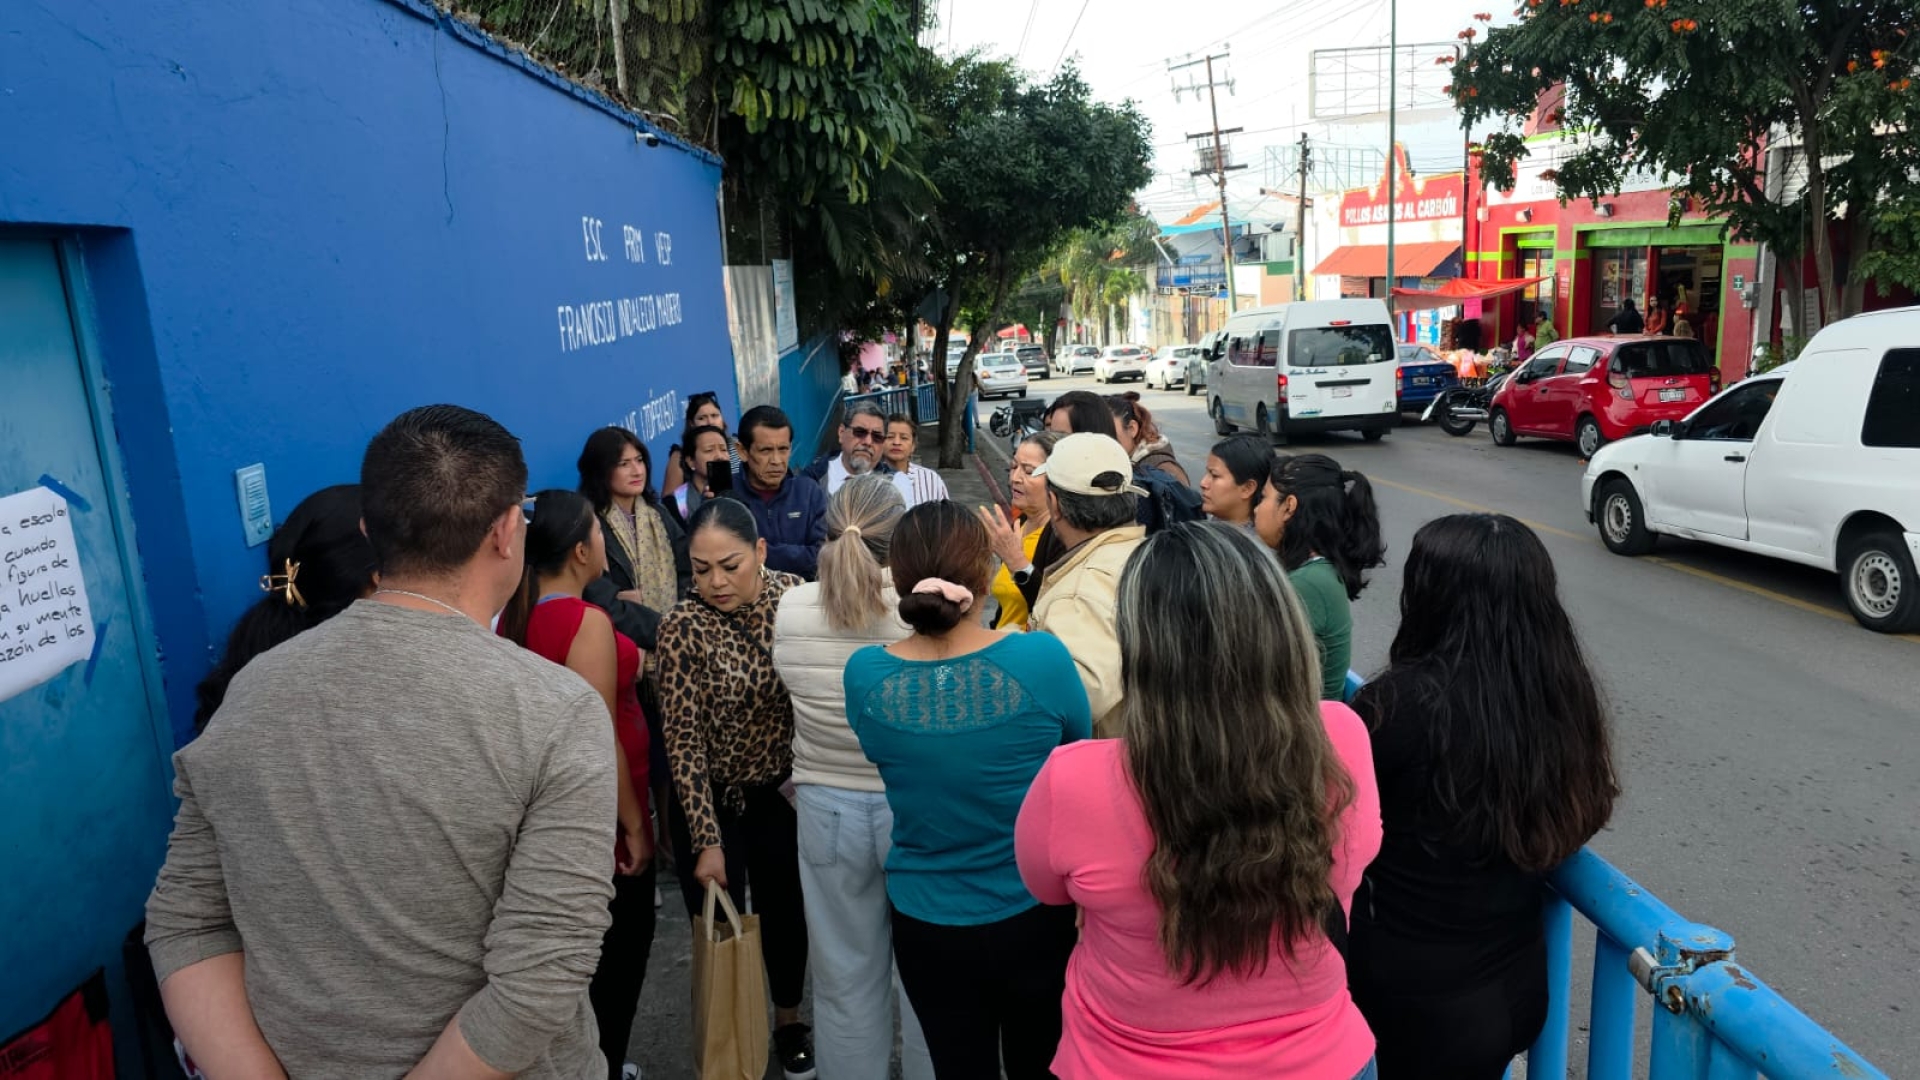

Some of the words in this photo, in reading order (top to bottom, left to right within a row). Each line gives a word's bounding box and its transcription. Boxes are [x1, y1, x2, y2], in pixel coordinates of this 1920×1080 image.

[1404, 201, 1416, 219] AL
[1417, 190, 1458, 217] CARBÓN
[557, 300, 616, 353] FRANCISCO
[4, 535, 56, 563] cuando
[51, 552, 70, 569] de
[18, 580, 76, 607] huellas
[16, 622, 30, 635] su
[36, 600, 82, 625] mente
[38, 630, 57, 647] de
[64, 623, 85, 640] los
